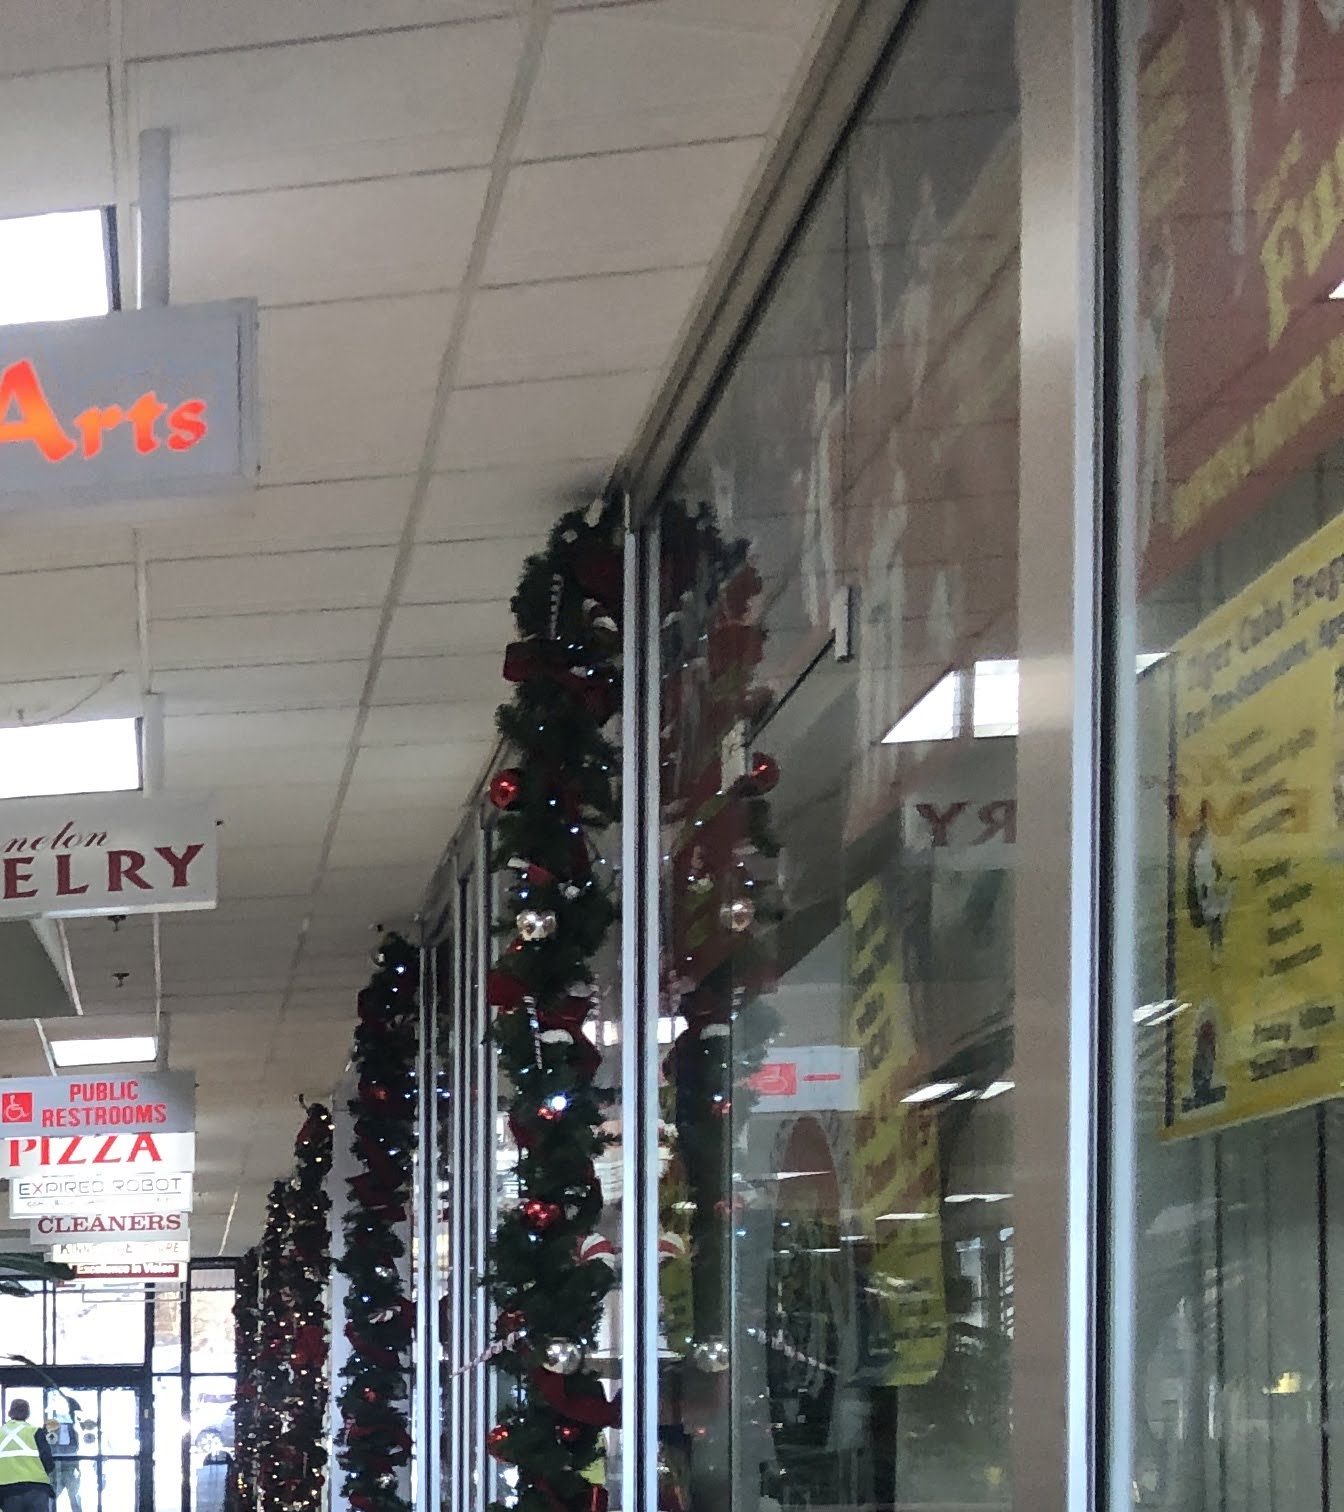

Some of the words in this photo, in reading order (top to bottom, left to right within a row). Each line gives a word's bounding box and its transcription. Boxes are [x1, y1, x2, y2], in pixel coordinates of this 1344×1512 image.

[69, 1081, 139, 1102] PUBLIC
[42, 1103, 168, 1128] RESTROOMS
[9, 1132, 162, 1167] PIZZA
[19, 1180, 104, 1195] EXPIRED
[113, 1178, 182, 1192] ROBOT
[38, 1214, 181, 1233] CLEANERS
